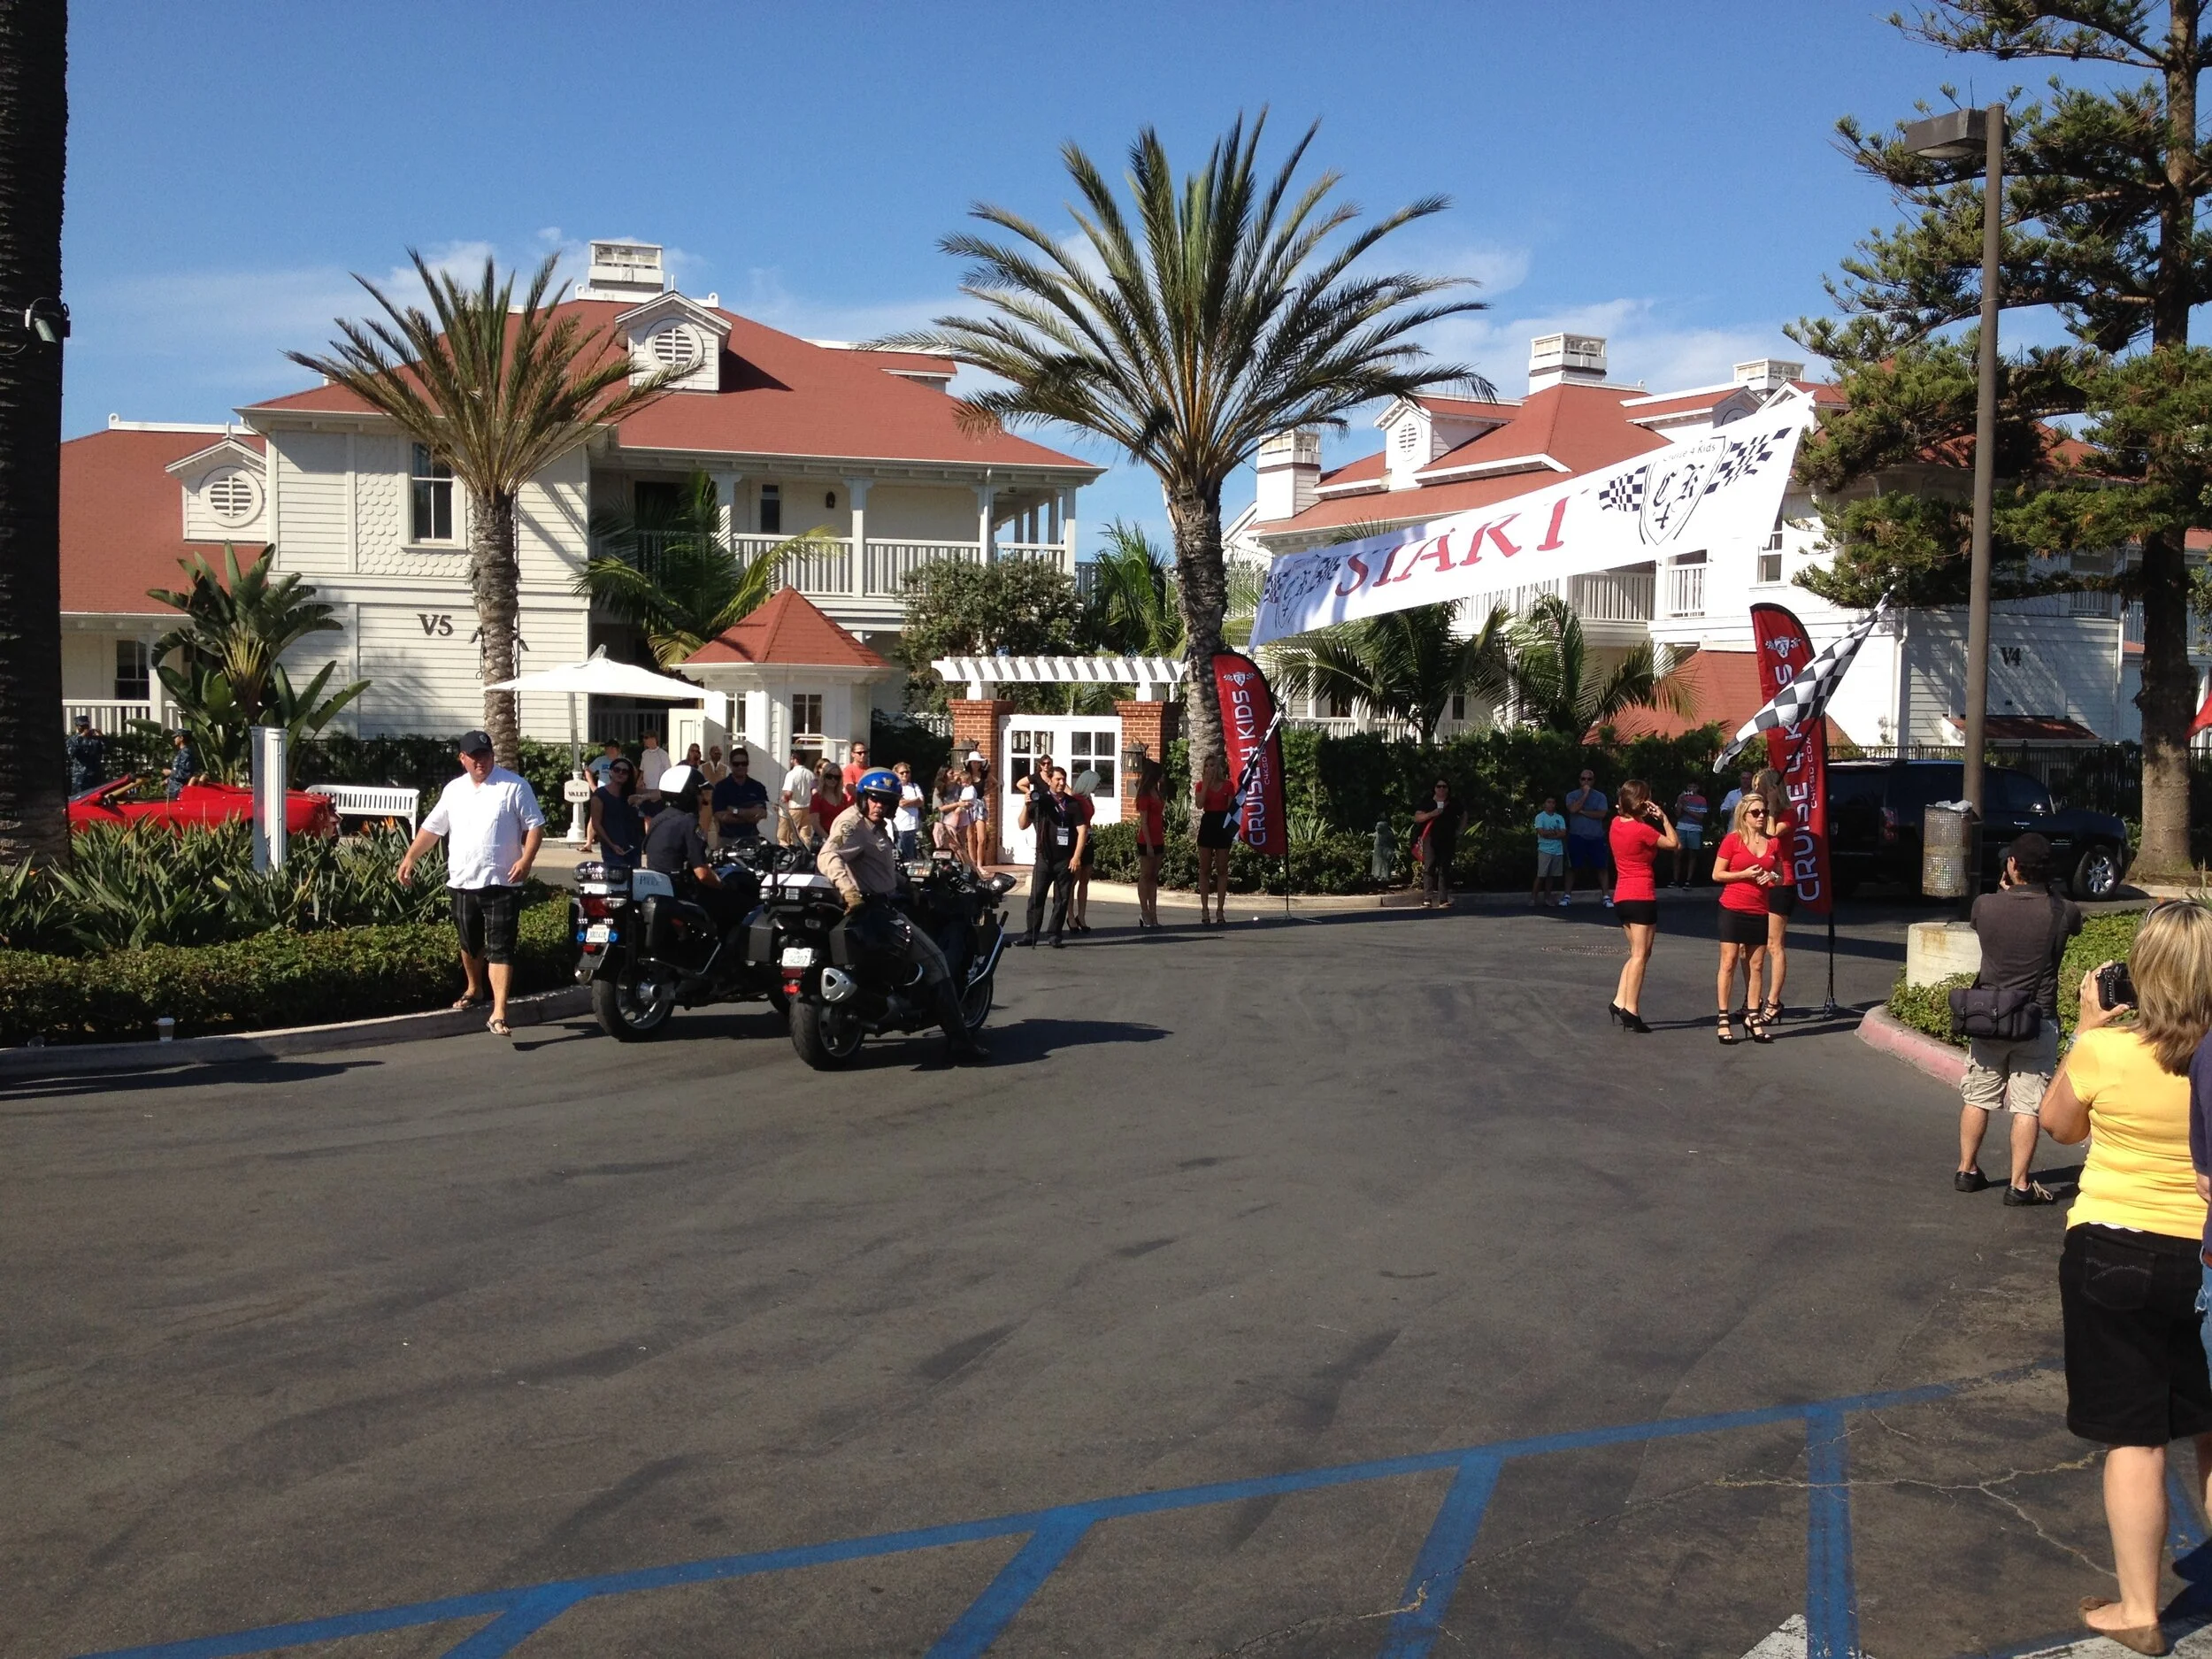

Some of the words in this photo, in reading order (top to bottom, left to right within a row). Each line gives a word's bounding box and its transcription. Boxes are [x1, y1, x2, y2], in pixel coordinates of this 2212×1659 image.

[1697, 443, 1716, 454] Kids
[417, 613, 454, 637] V5
[2001, 647, 2022, 666] V4
[1775, 664, 1802, 740] KS
[1232, 689, 1256, 740] KIDS
[1240, 746, 1258, 761] 4
[1786, 751, 1804, 772] 4
[1786, 782, 1820, 902] CRUISE
